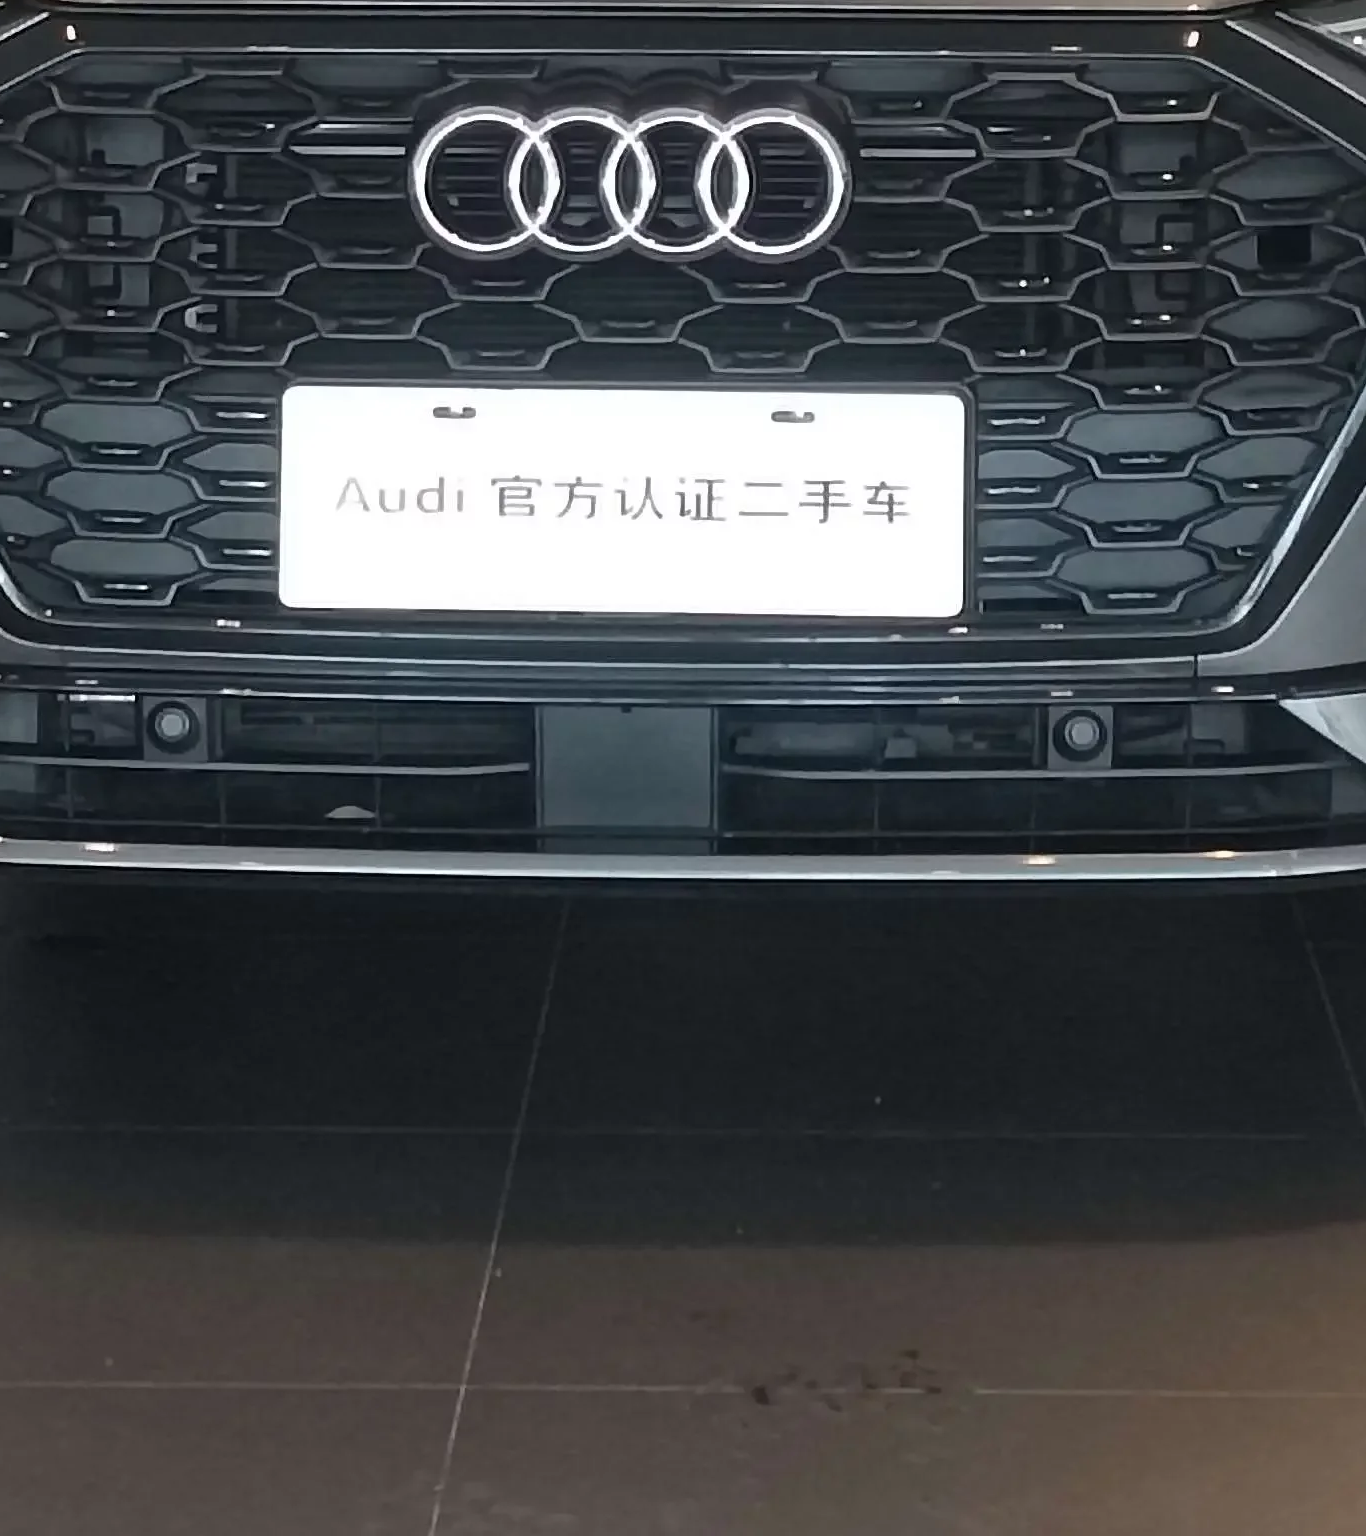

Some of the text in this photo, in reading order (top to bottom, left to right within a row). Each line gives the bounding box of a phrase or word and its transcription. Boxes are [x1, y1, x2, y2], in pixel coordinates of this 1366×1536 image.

[335, 474, 911, 524] Audi 官方认证二手车
